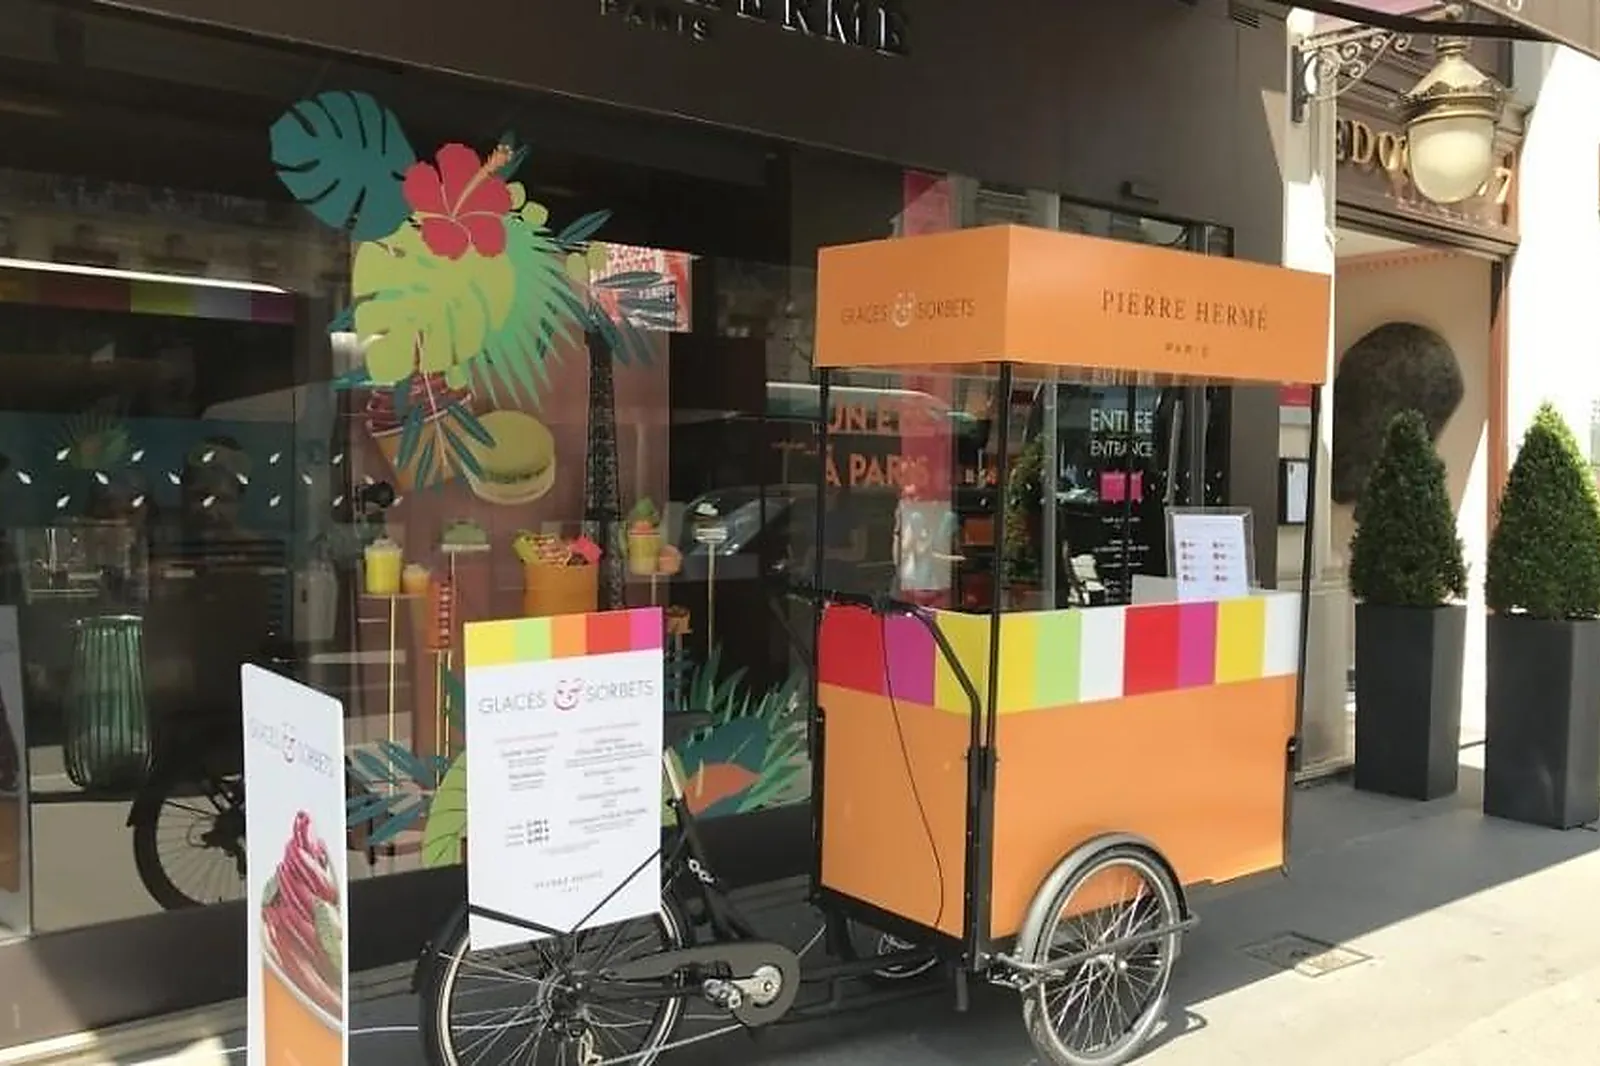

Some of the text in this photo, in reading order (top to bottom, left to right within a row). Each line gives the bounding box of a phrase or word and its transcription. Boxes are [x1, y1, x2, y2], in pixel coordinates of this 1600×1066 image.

[1101, 287, 1269, 332] PIERRE HERMÉ
[478, 690, 548, 715] GLACES
[587, 679, 656, 704] SORBETS
